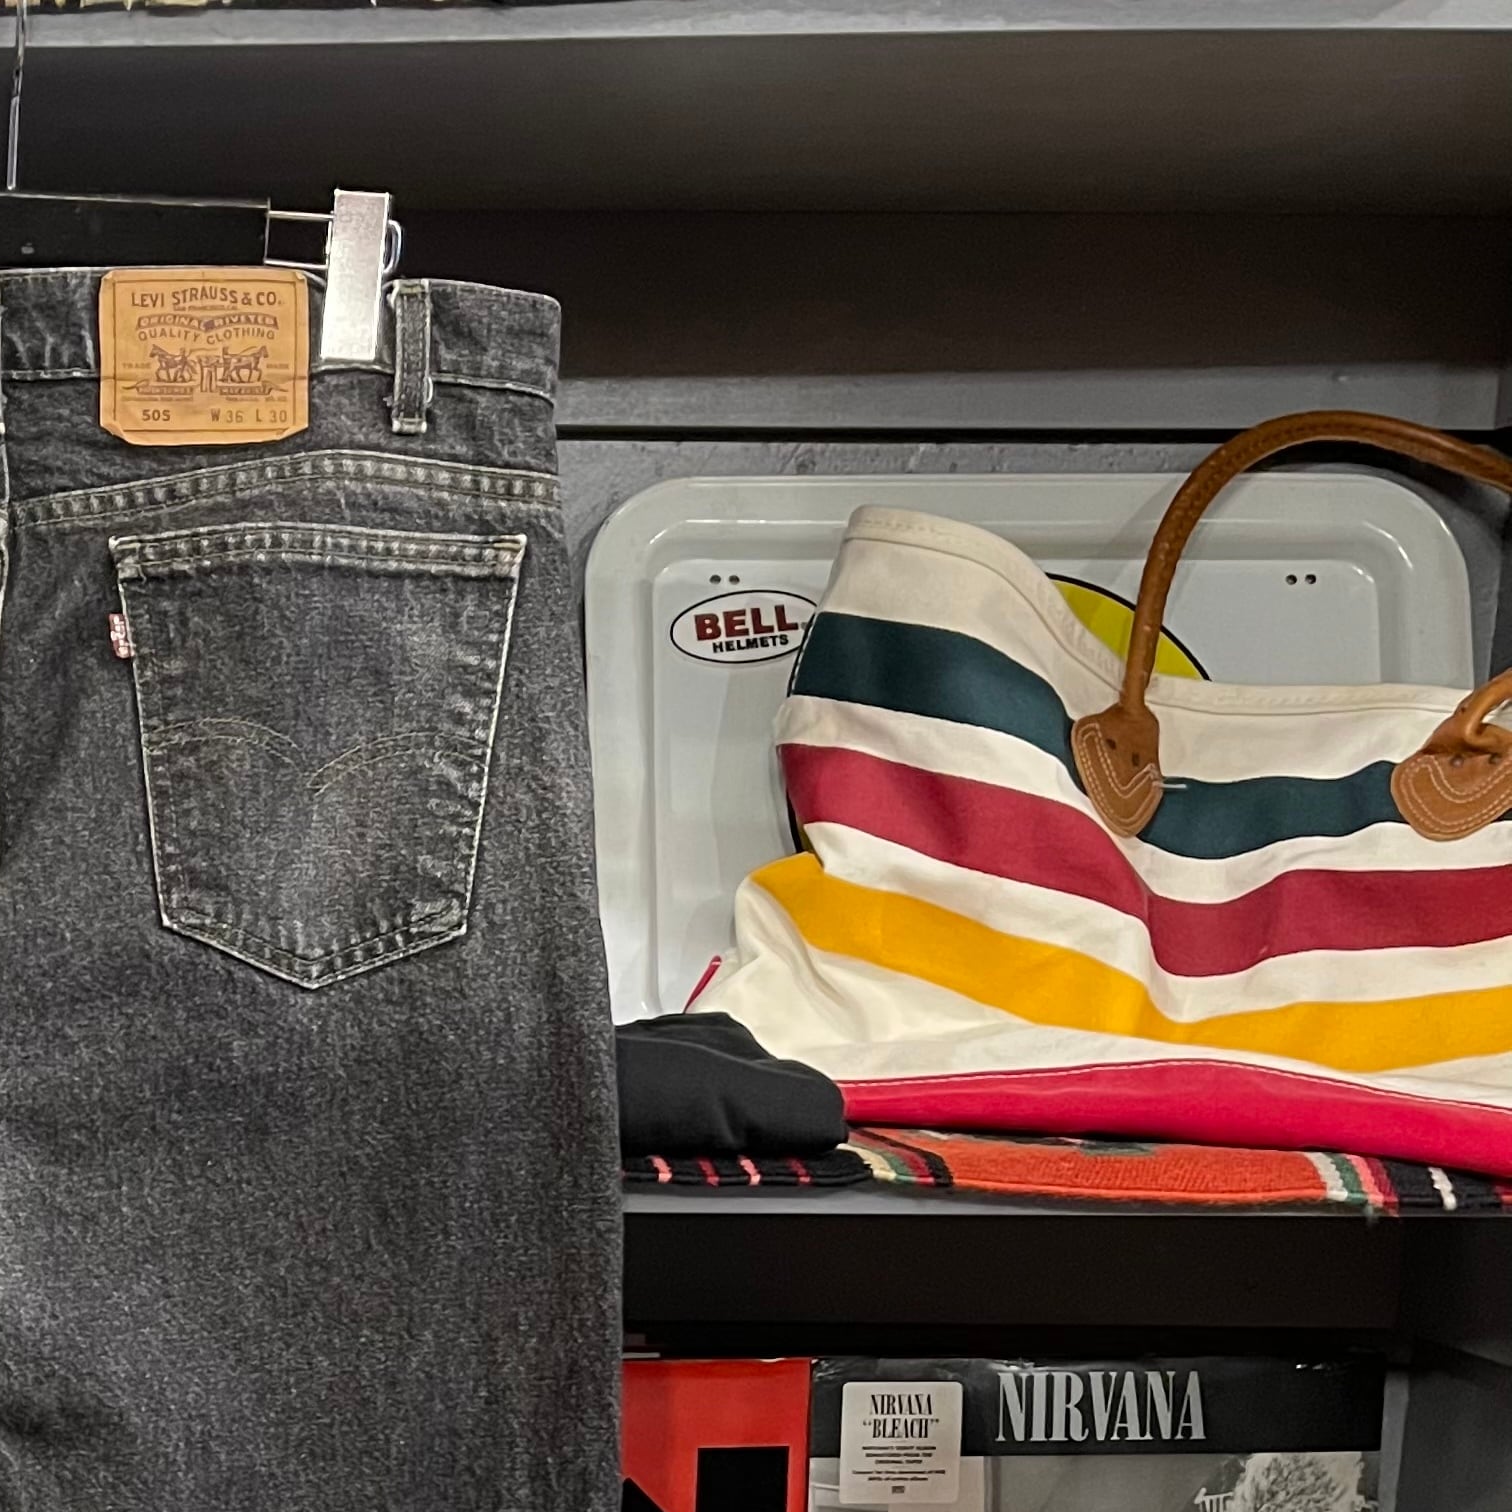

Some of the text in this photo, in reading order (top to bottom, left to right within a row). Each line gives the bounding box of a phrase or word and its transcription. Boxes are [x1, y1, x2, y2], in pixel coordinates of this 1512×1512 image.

[131, 292, 165, 308] LEVI
[172, 285, 238, 307] STRAUSS
[241, 291, 252, 307] &
[256, 291, 282, 307] CO.
[138, 327, 276, 345] QUALITY CLOTHING
[210, 407, 221, 422] W
[226, 410, 245, 424] 36
[255, 408, 263, 423] L
[269, 409, 288, 424] 30
[694, 604, 799, 641] BELL
[712, 634, 789, 653] HELMETS
[869, 1393, 933, 1416] NIRVANA
[994, 1370, 1207, 1442] NIRVANA
